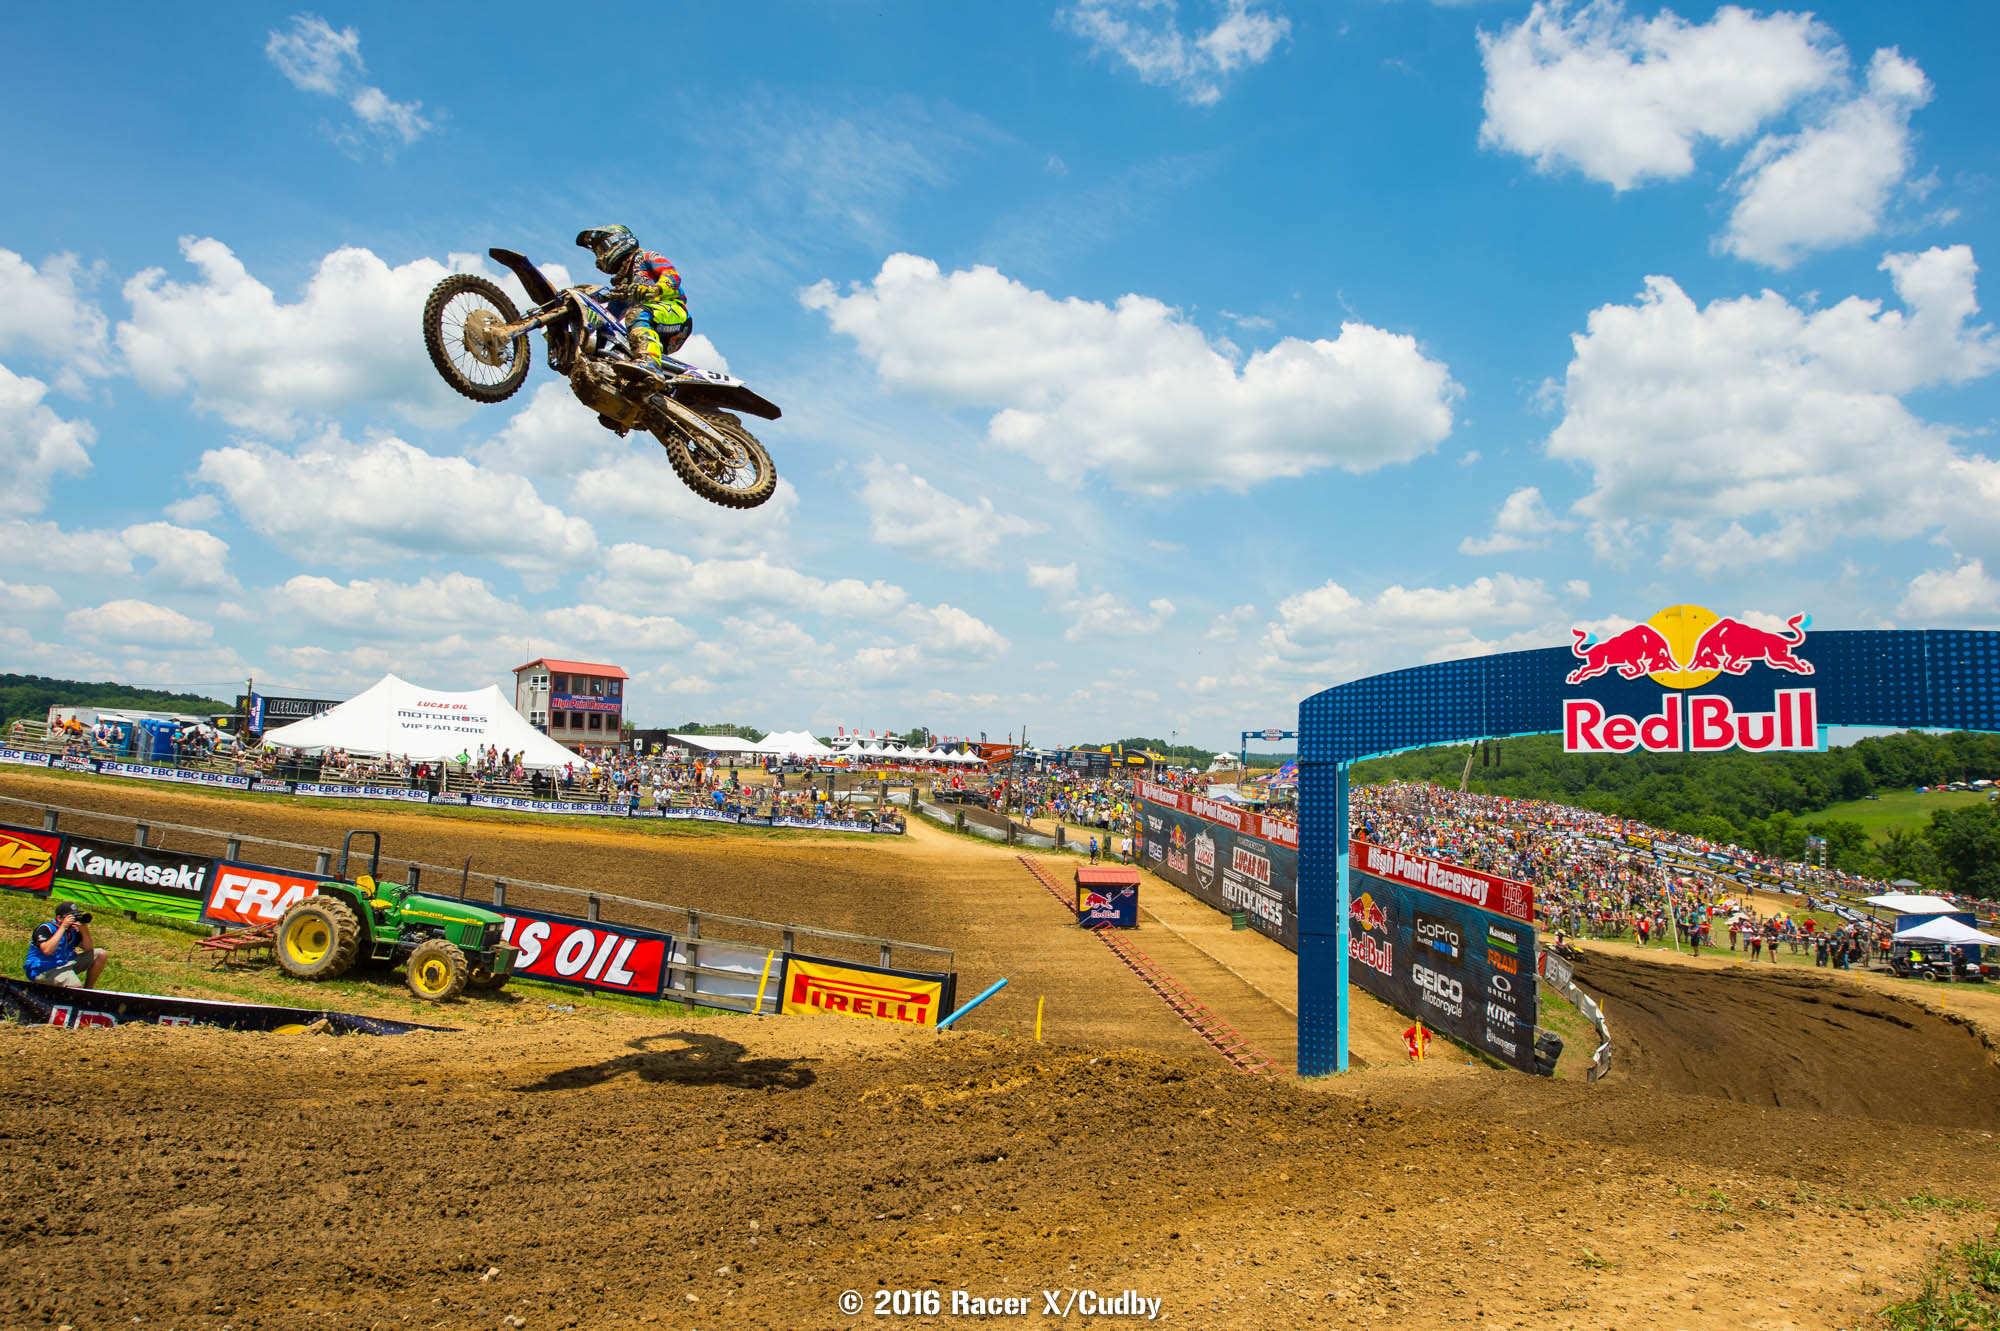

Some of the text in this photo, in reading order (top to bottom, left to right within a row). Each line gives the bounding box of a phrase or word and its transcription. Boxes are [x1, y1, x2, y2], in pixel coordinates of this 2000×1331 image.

[269, 700, 313, 715] OFFICIAL
[397, 711, 488, 723] MOTOCROSS
[417, 701, 449, 709] LUCAS
[552, 698, 619, 712] High Point Raceway
[454, 726, 485, 734] ZONE
[1565, 690, 1816, 751] Red Bull
[24, 752, 48, 762] EBC
[100, 761, 123, 771] EBC
[126, 764, 149, 774] EBC
[151, 767, 174, 777] EBC
[176, 770, 199, 779] EBC
[201, 773, 223, 782] EBC
[225, 776, 248, 785] EBC
[297, 783, 316, 791] EBC
[319, 784, 339, 792] EBC
[341, 785, 361, 794] EBC
[364, 786, 385, 795] EBC
[386, 788, 406, 796] EBC
[408, 790, 428, 798] EBC
[471, 794, 628, 813] EBC EBC EBC EBC EBC EBC EBC EBC
[704, 809, 719, 817] EBC
[722, 812, 737, 820] EBC
[1261, 816, 1276, 840] High
[1277, 821, 1296, 844] Point
[65, 847, 206, 891] Kawasaki
[1234, 849, 1256, 877] LUCAS
[1257, 858, 1268, 881] OIL
[1368, 846, 1393, 875] High
[1394, 853, 1427, 884] Point
[1428, 863, 1489, 906] Raceway
[210, 874, 319, 918] FRA
[1223, 877, 1283, 926] MOTOCROSS
[1502, 882, 1523, 901] High
[1091, 910, 1120, 918] Red Bull
[1503, 898, 1527, 919] Point
[1417, 919, 1459, 946] GoPro
[1489, 926, 1516, 944] Kawasaki
[555, 929, 637, 985] OIL
[1367, 935, 1392, 976] Bull
[1488, 949, 1518, 976] FRAM
[1412, 963, 1463, 1003] GEICO
[1487, 986, 1517, 1005] OAKLEY
[792, 973, 931, 1025] PIRELLI
[1423, 988, 1462, 1018] Motorcycle
[1487, 1001, 1516, 1028] KMC
